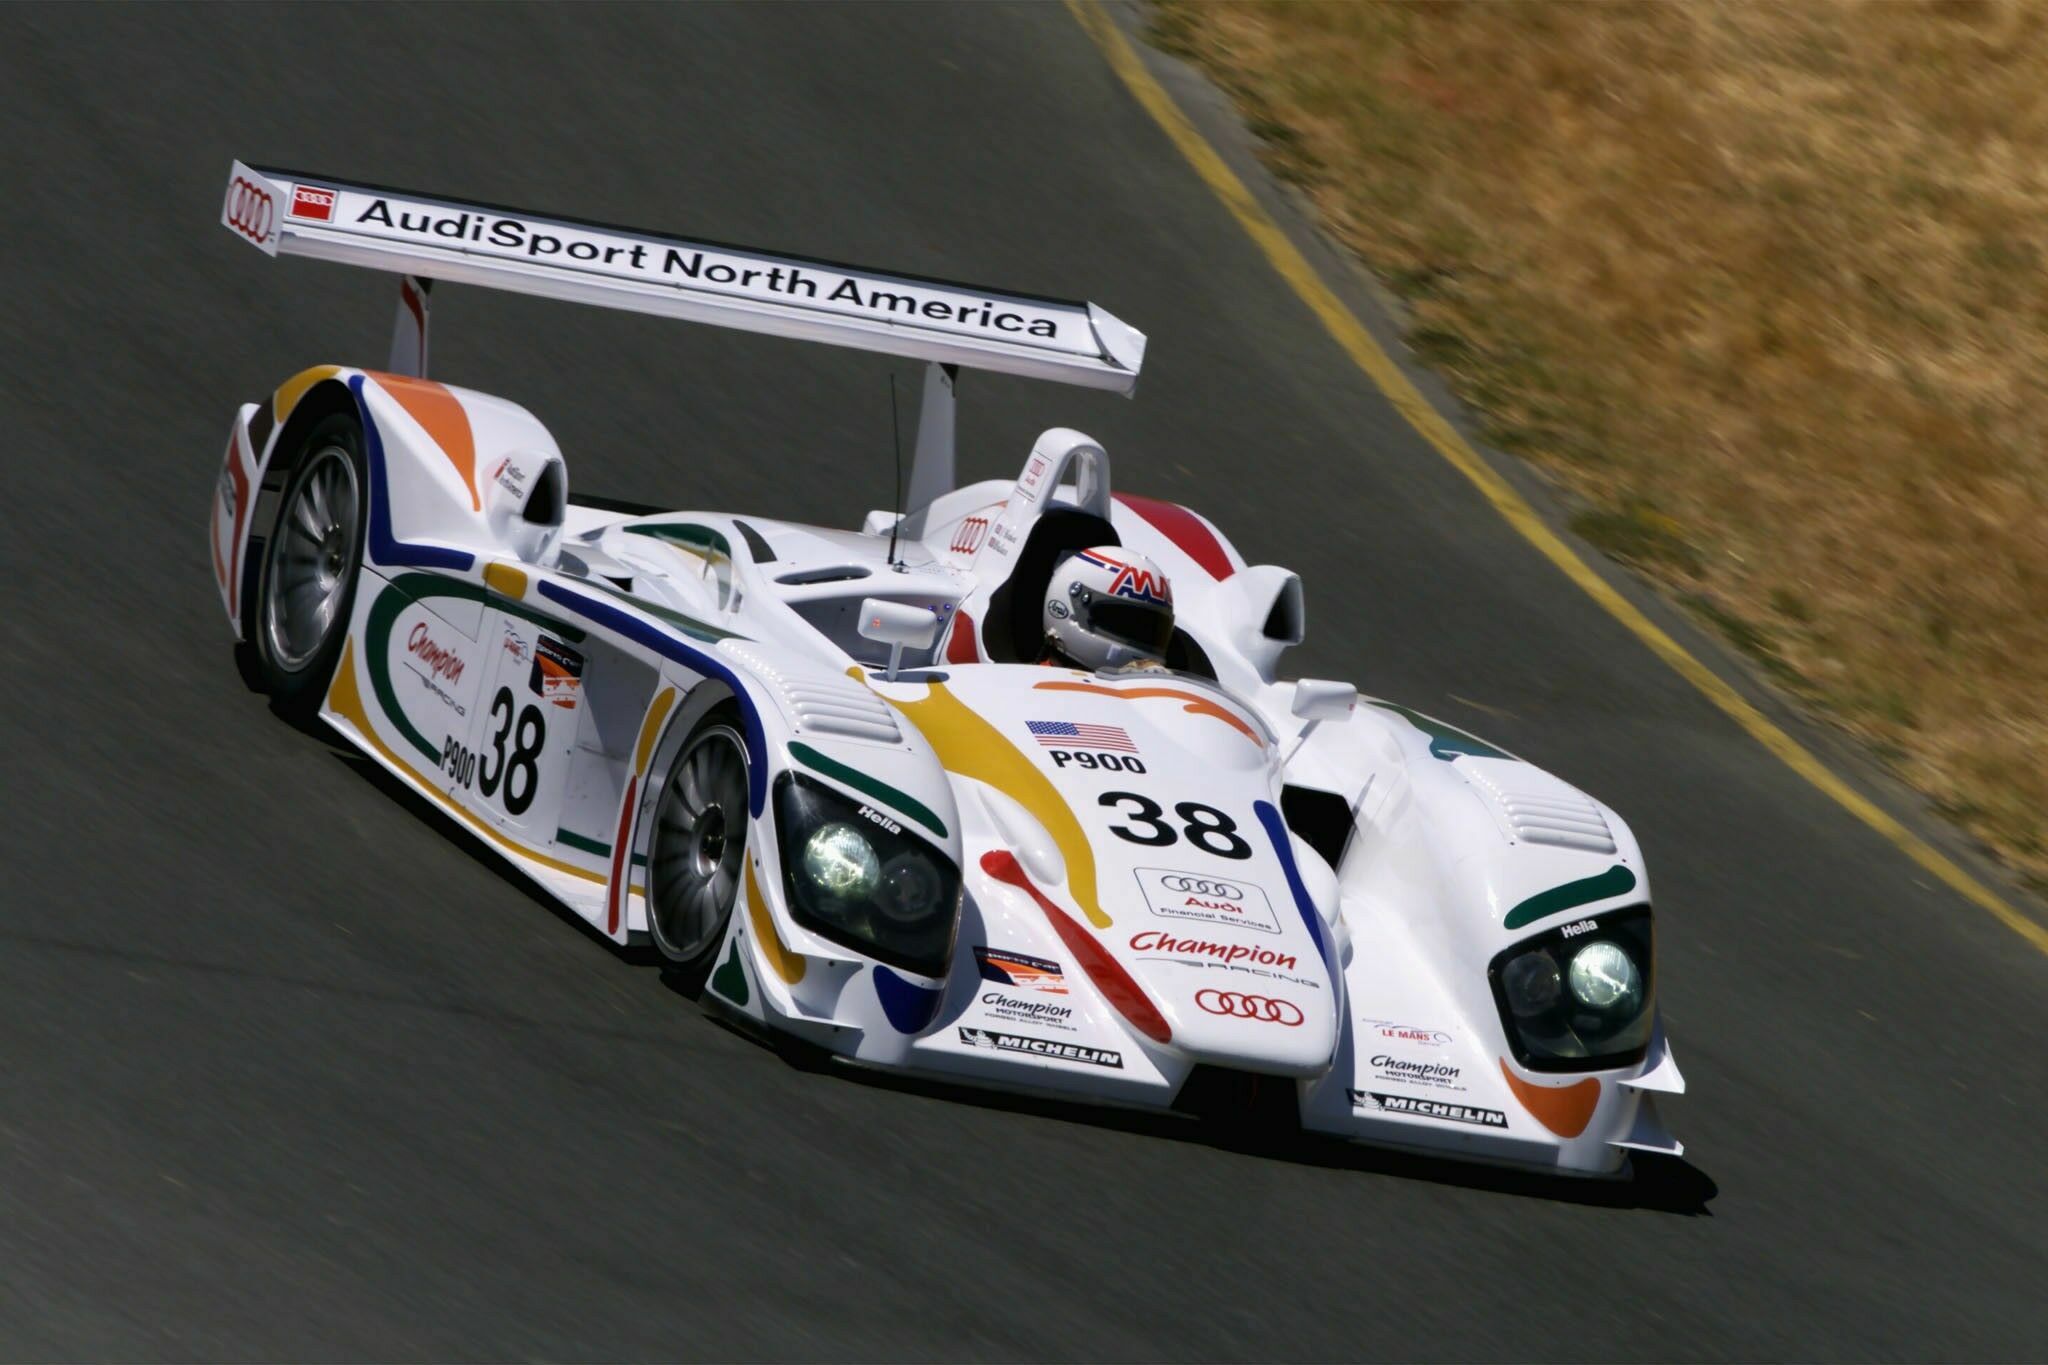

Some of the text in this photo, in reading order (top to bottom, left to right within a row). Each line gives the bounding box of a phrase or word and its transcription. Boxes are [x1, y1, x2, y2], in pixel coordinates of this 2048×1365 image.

[357, 199, 1057, 339] AudiSport North America
[407, 622, 465, 686] Champion
[440, 734, 476, 790] P900
[478, 685, 546, 816] 38
[1049, 750, 1147, 775] P900
[857, 804, 902, 835] Hella
[1097, 791, 1253, 860] 38
[1160, 907, 1272, 930] Financial Services
[1560, 919, 1599, 939] Hella
[1129, 931, 1297, 970] Champion
[982, 993, 1073, 1018] Champion
[1382, 1029, 1431, 1041] LE MANS
[997, 1036, 1119, 1065] MICHELIN
[1370, 1055, 1461, 1078] Champion
[1384, 1097, 1505, 1125] MICHELIN
